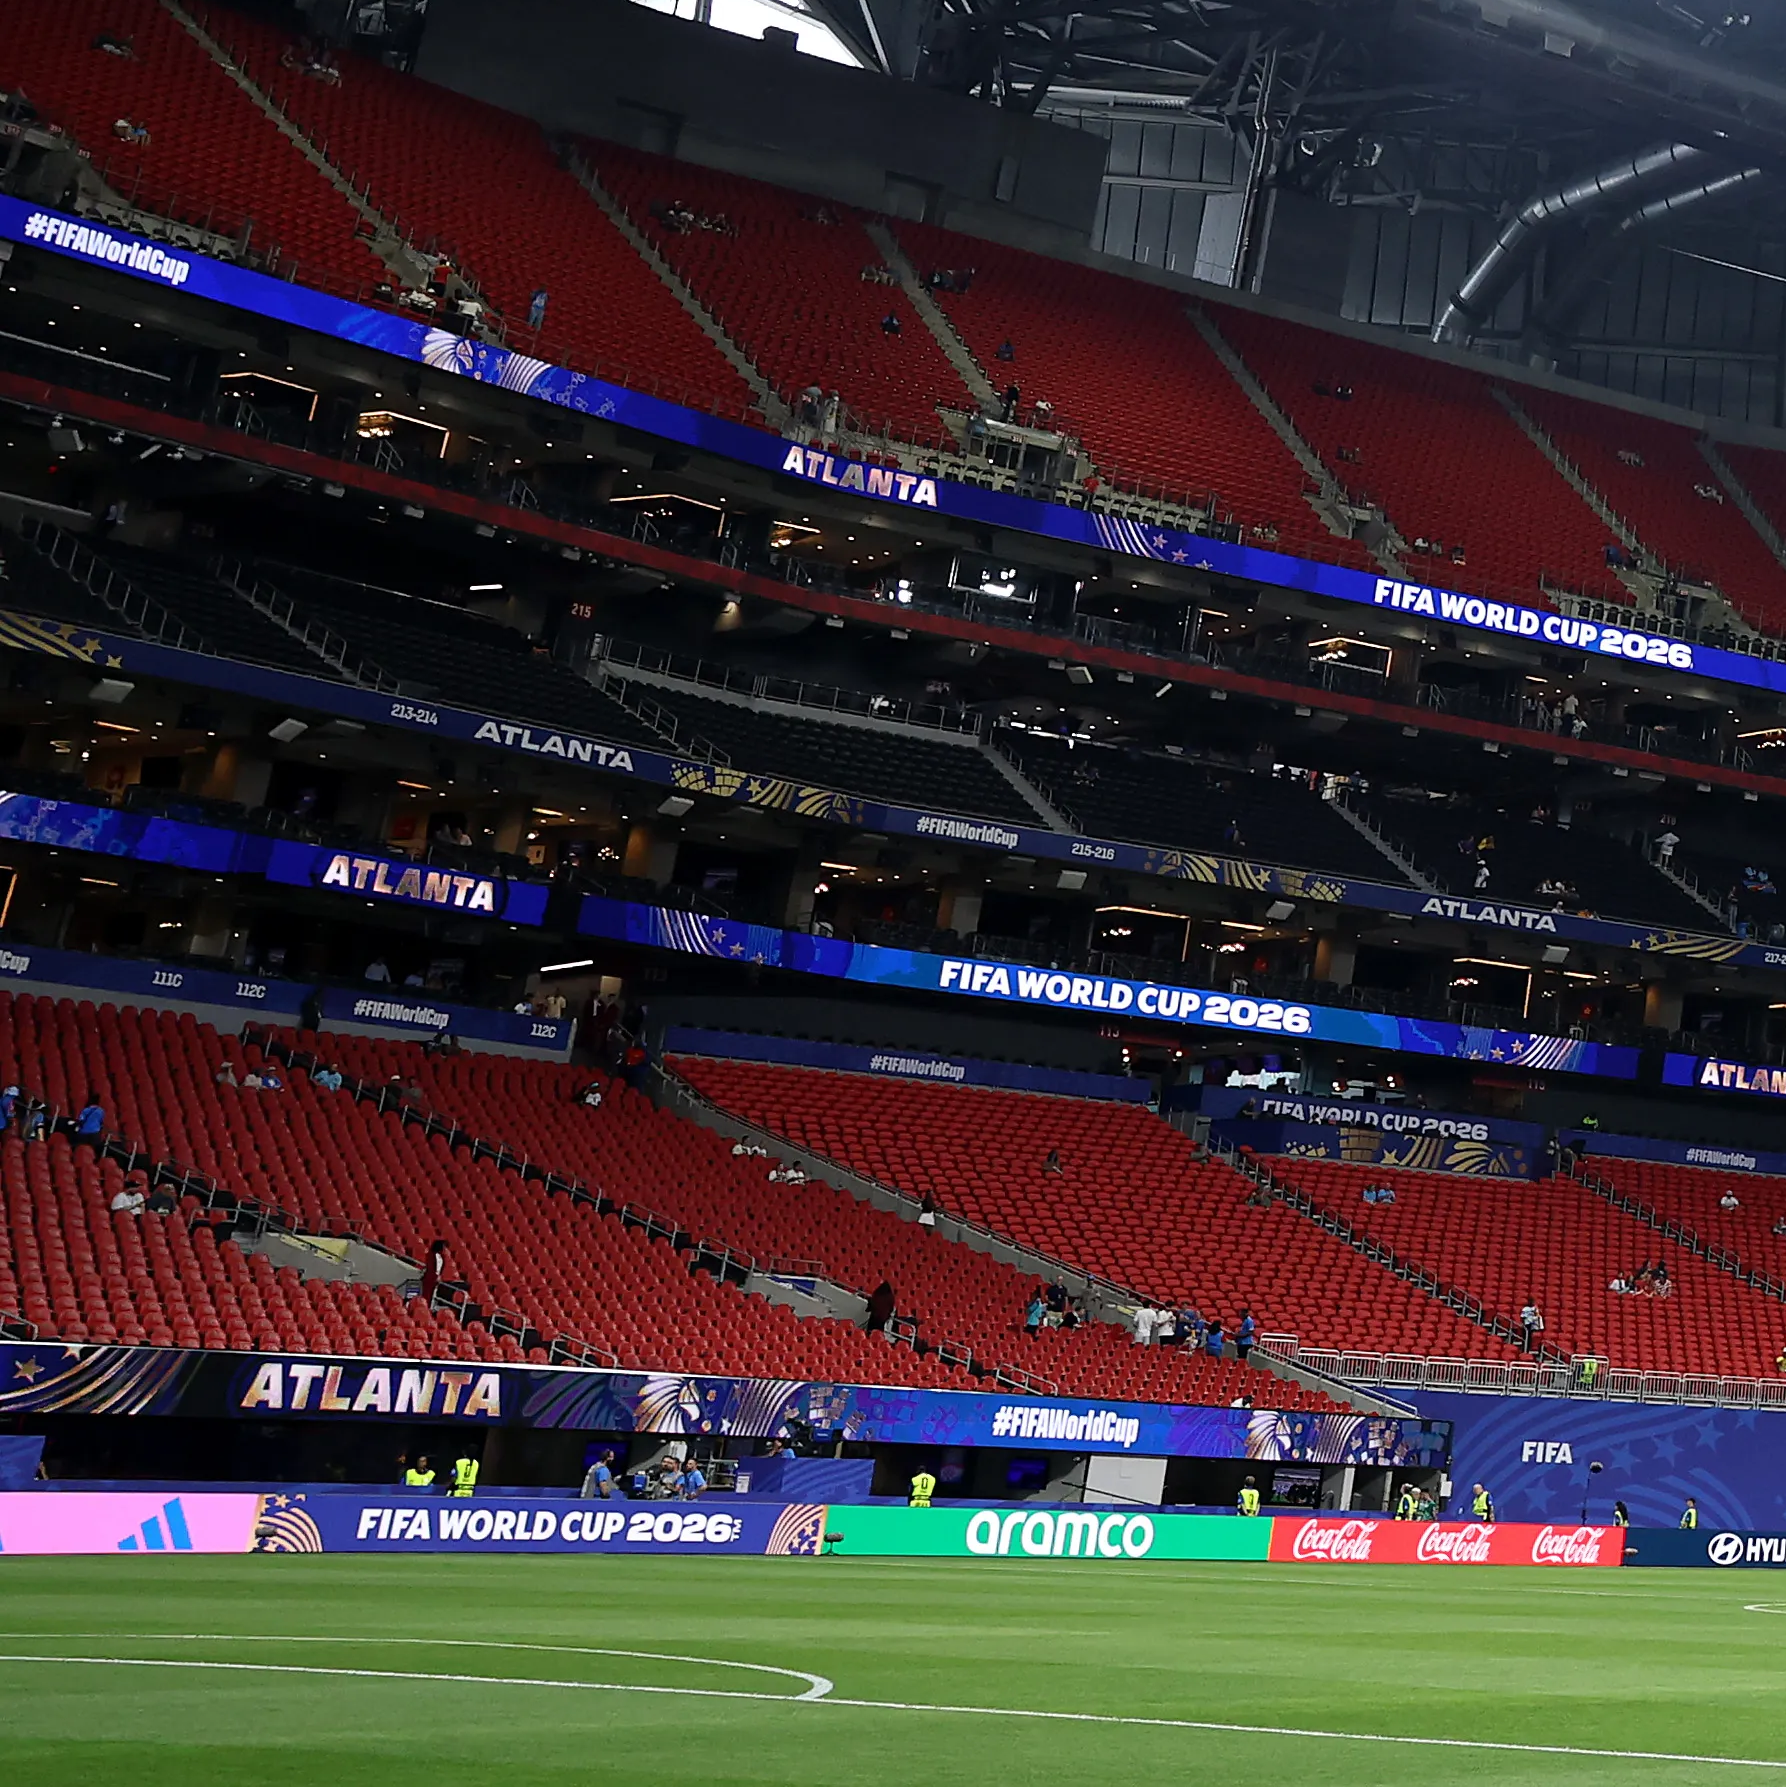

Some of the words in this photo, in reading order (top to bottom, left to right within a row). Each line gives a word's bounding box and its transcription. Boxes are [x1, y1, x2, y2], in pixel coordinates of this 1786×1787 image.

[25, 213, 189, 285] #FIFAWorldCup
[783, 444, 940, 506] ATLANTA
[571, 602, 593, 619] 215
[1375, 579, 1434, 614] FIFA
[1441, 593, 1539, 634] WORLD
[1544, 614, 1599, 646] CUP
[1600, 627, 1692, 668] 2026
[391, 701, 440, 725] 213-214
[474, 718, 637, 771] ATLANTA
[917, 814, 1020, 849] #FIFAWorldCup
[1072, 840, 1117, 859] 215-216
[323, 851, 493, 911] ATLANTA
[1422, 896, 1558, 932] ATLANTA
[152, 971, 182, 987] 111C
[236, 983, 266, 998] 112C
[940, 958, 1010, 995] FIFA
[1018, 967, 1133, 1009] WORLD
[1138, 987, 1200, 1018] CUP
[1203, 996, 1309, 1032] 2026
[353, 998, 450, 1030] #FIFAWorldCup
[531, 1024, 556, 1038] 112C
[869, 1054, 966, 1081] #FIFAWorldCup
[1686, 1147, 1757, 1170] #FIFAWorldCup
[238, 1359, 505, 1420] ATLANTA
[993, 1406, 1139, 1448] #FIFAWorldCup
[1522, 1442, 1572, 1463] FIFA
[357, 1509, 430, 1539] FIFA
[440, 1510, 556, 1540] WORLD
[561, 1511, 625, 1540] CUP
[625, 1510, 732, 1545] 2026
[966, 1510, 1154, 1558] aramco
[1293, 1519, 1378, 1559] Coca-Cola
[1417, 1520, 1496, 1561] Coca-Cola
[1532, 1526, 1605, 1563] Coca-Cola
